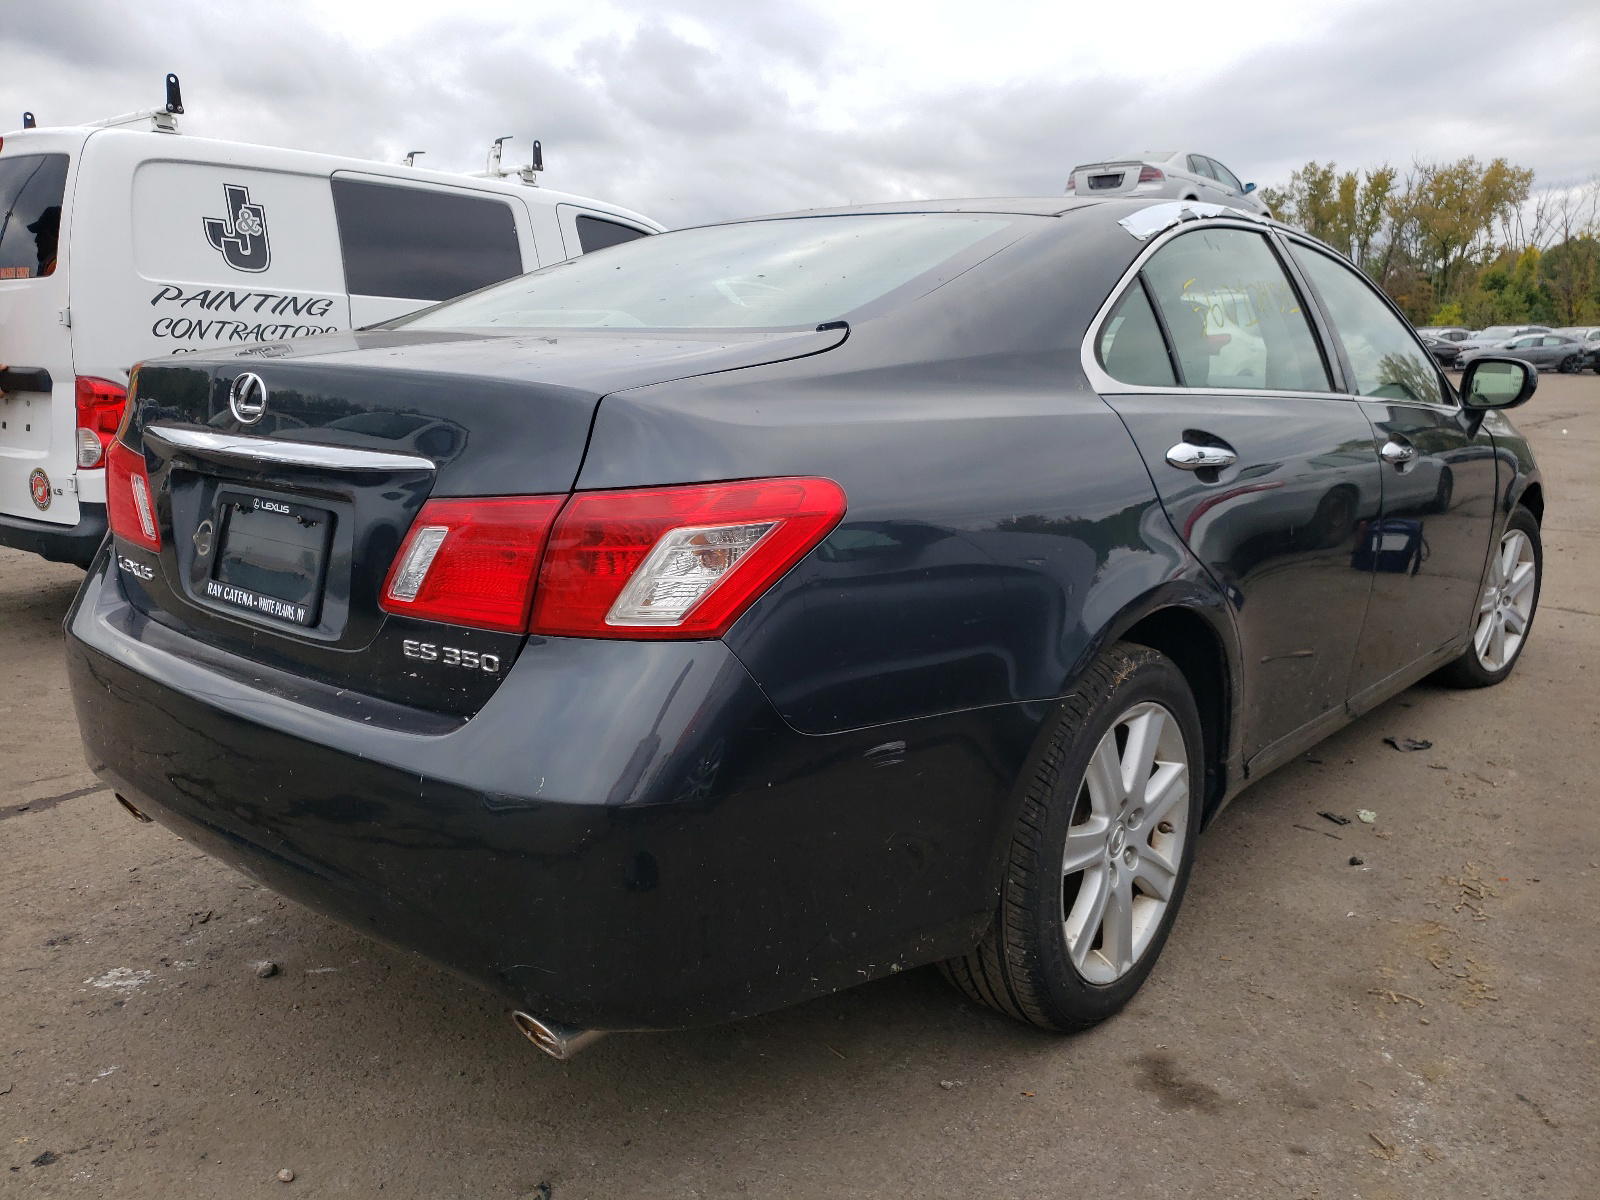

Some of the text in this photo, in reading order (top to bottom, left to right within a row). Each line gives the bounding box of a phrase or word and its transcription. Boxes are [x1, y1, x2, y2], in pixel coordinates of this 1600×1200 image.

[150, 284, 334, 318] PAINTING
[261, 501, 289, 514] LEXUS
[207, 582, 223, 597] RAY
[223, 587, 253, 607] CATENA
[258, 596, 276, 613] WHITE
[296, 608, 306, 622] NY
[403, 640, 499, 673] ES 350
